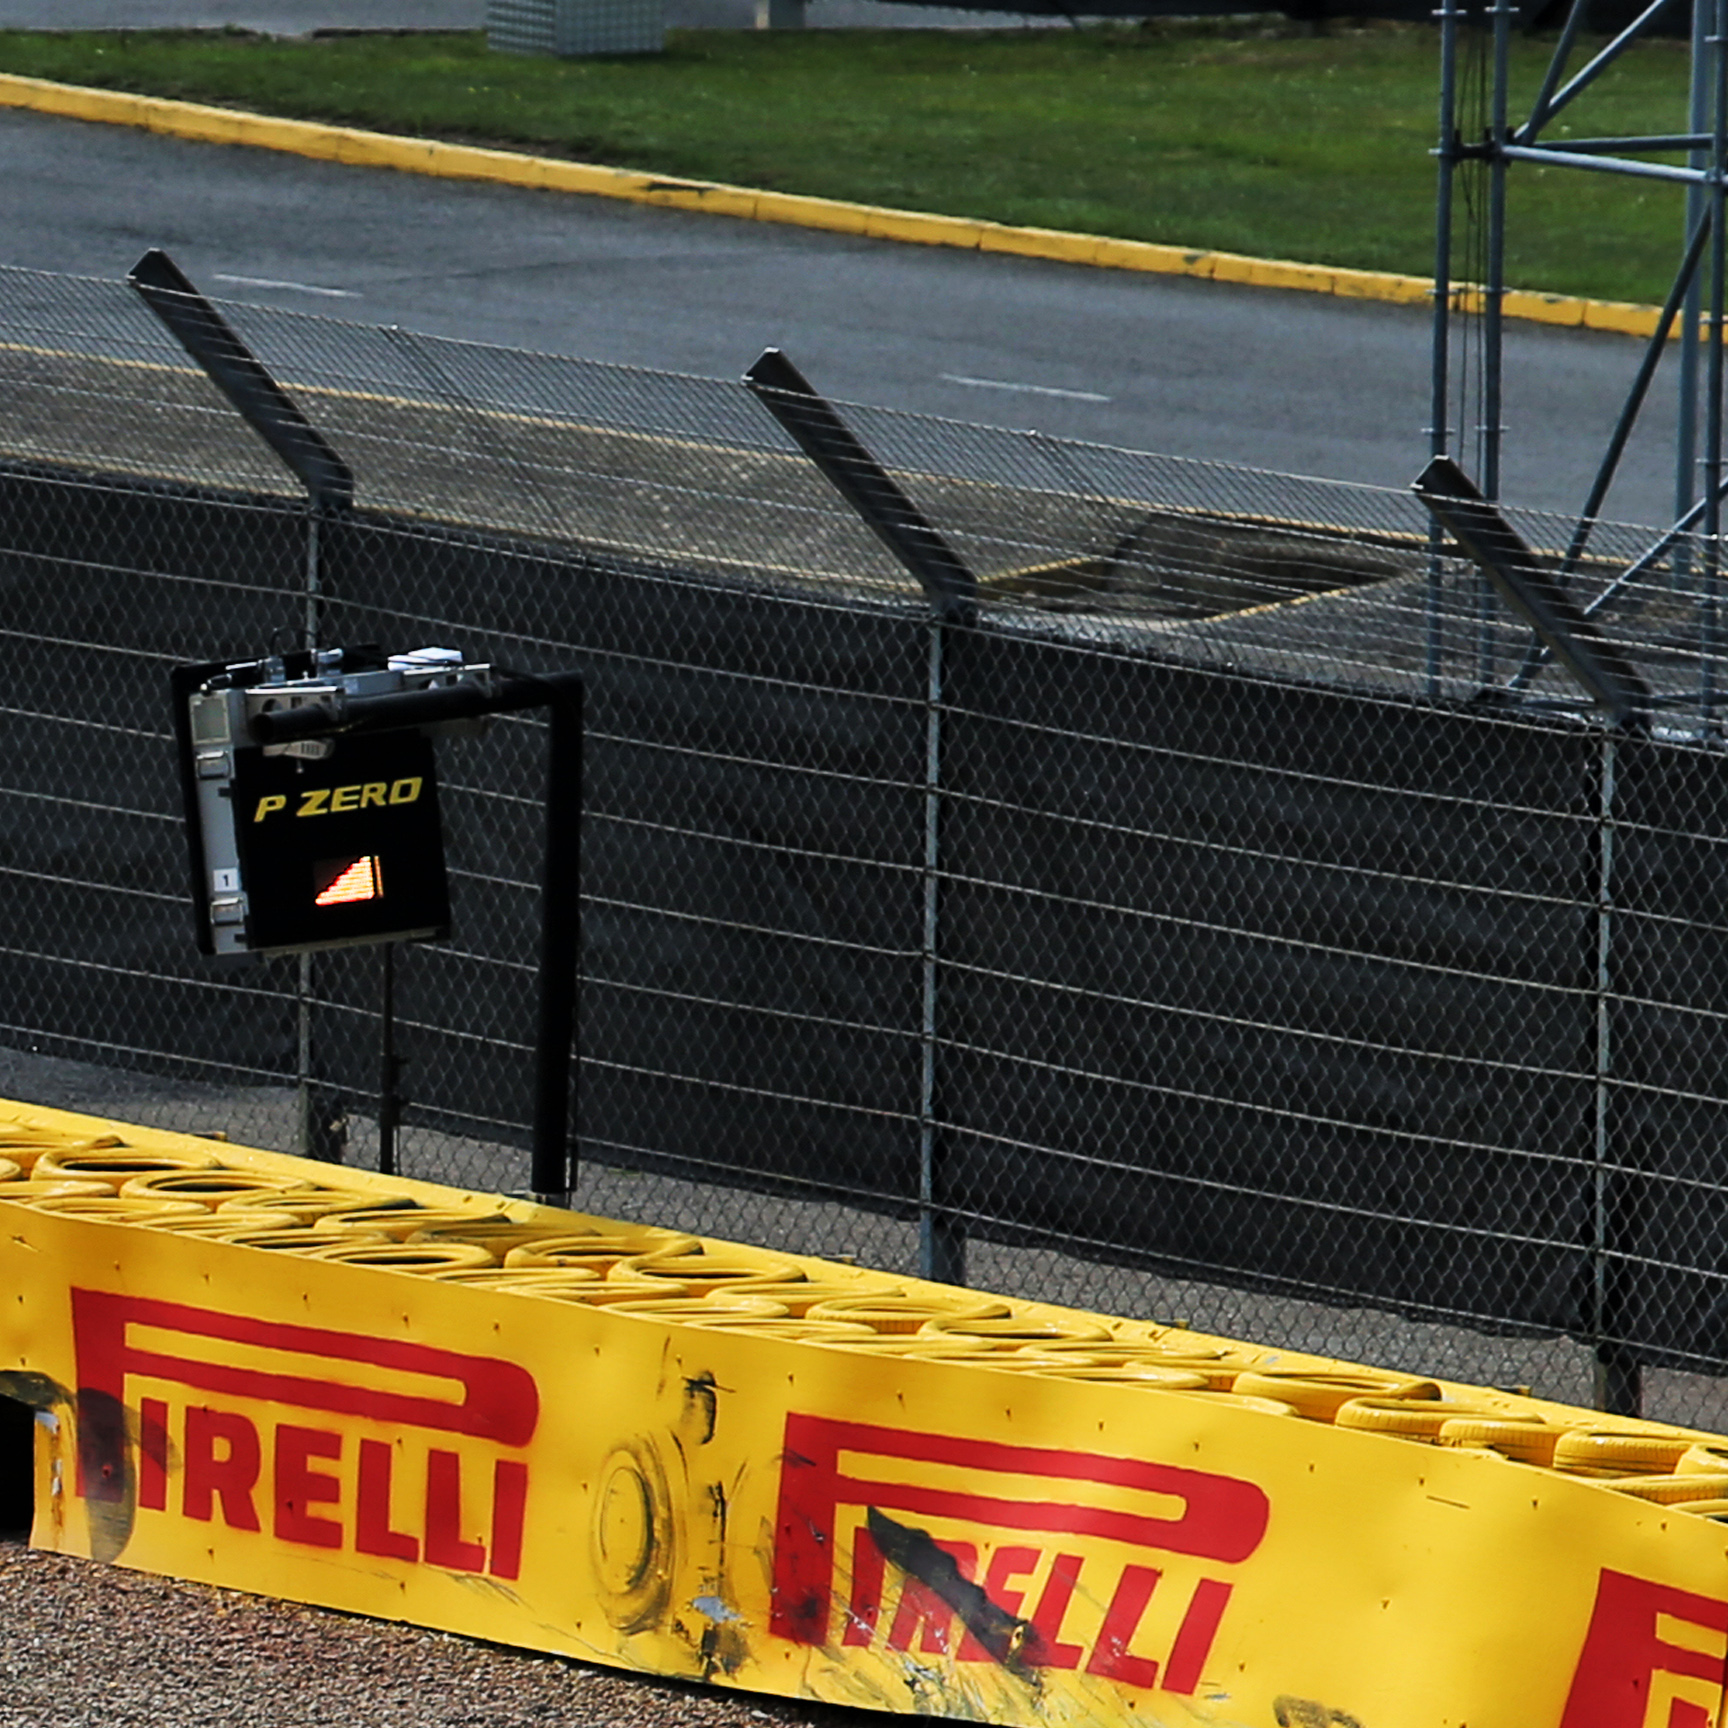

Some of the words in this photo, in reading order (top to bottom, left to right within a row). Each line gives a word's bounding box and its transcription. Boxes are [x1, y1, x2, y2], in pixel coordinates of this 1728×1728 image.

[253, 795, 287, 823] P
[296, 776, 423, 817] ZERO
[70, 1286, 540, 1580] PIRELLI
[768, 1412, 1270, 1696] PIRELLI
